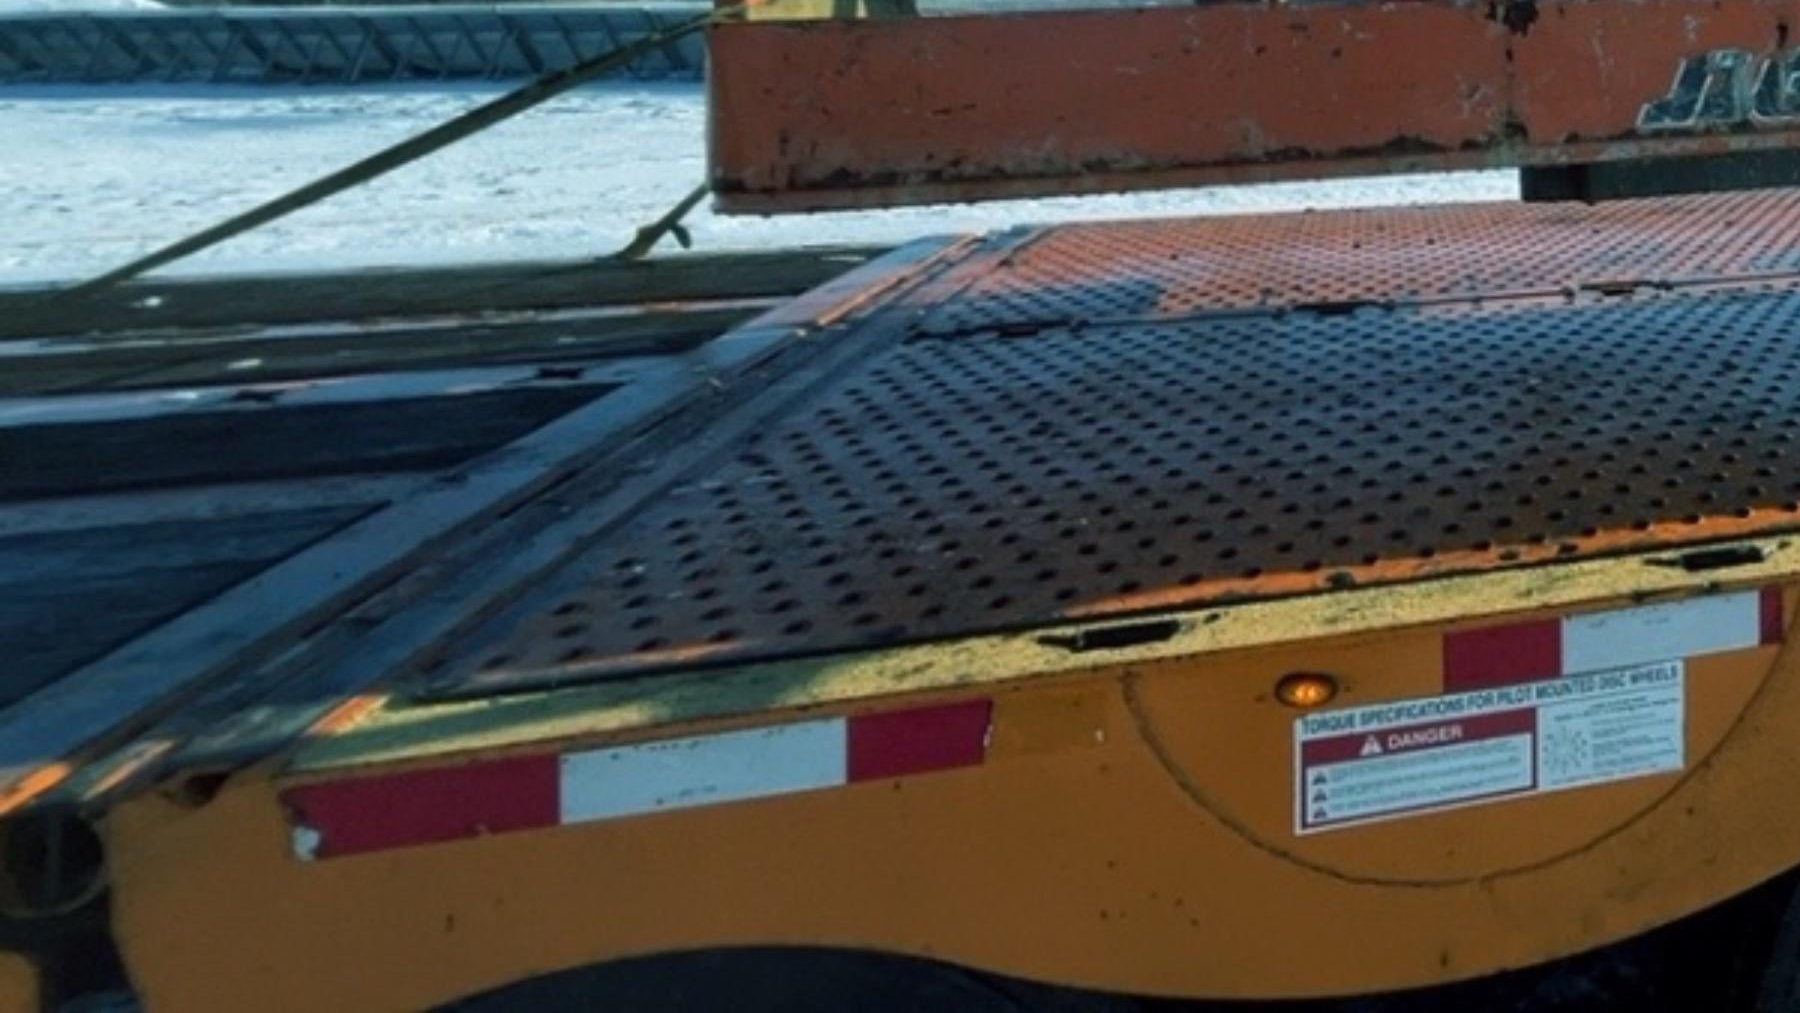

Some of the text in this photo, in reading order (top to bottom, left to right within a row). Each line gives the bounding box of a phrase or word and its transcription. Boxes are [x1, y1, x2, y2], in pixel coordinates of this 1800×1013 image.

[1301, 663, 1678, 736] TORQUE SPECIFICATIONS FOR PILOT MOUNTED DISC WHEELS
[1388, 724, 1463, 750] DANGER
